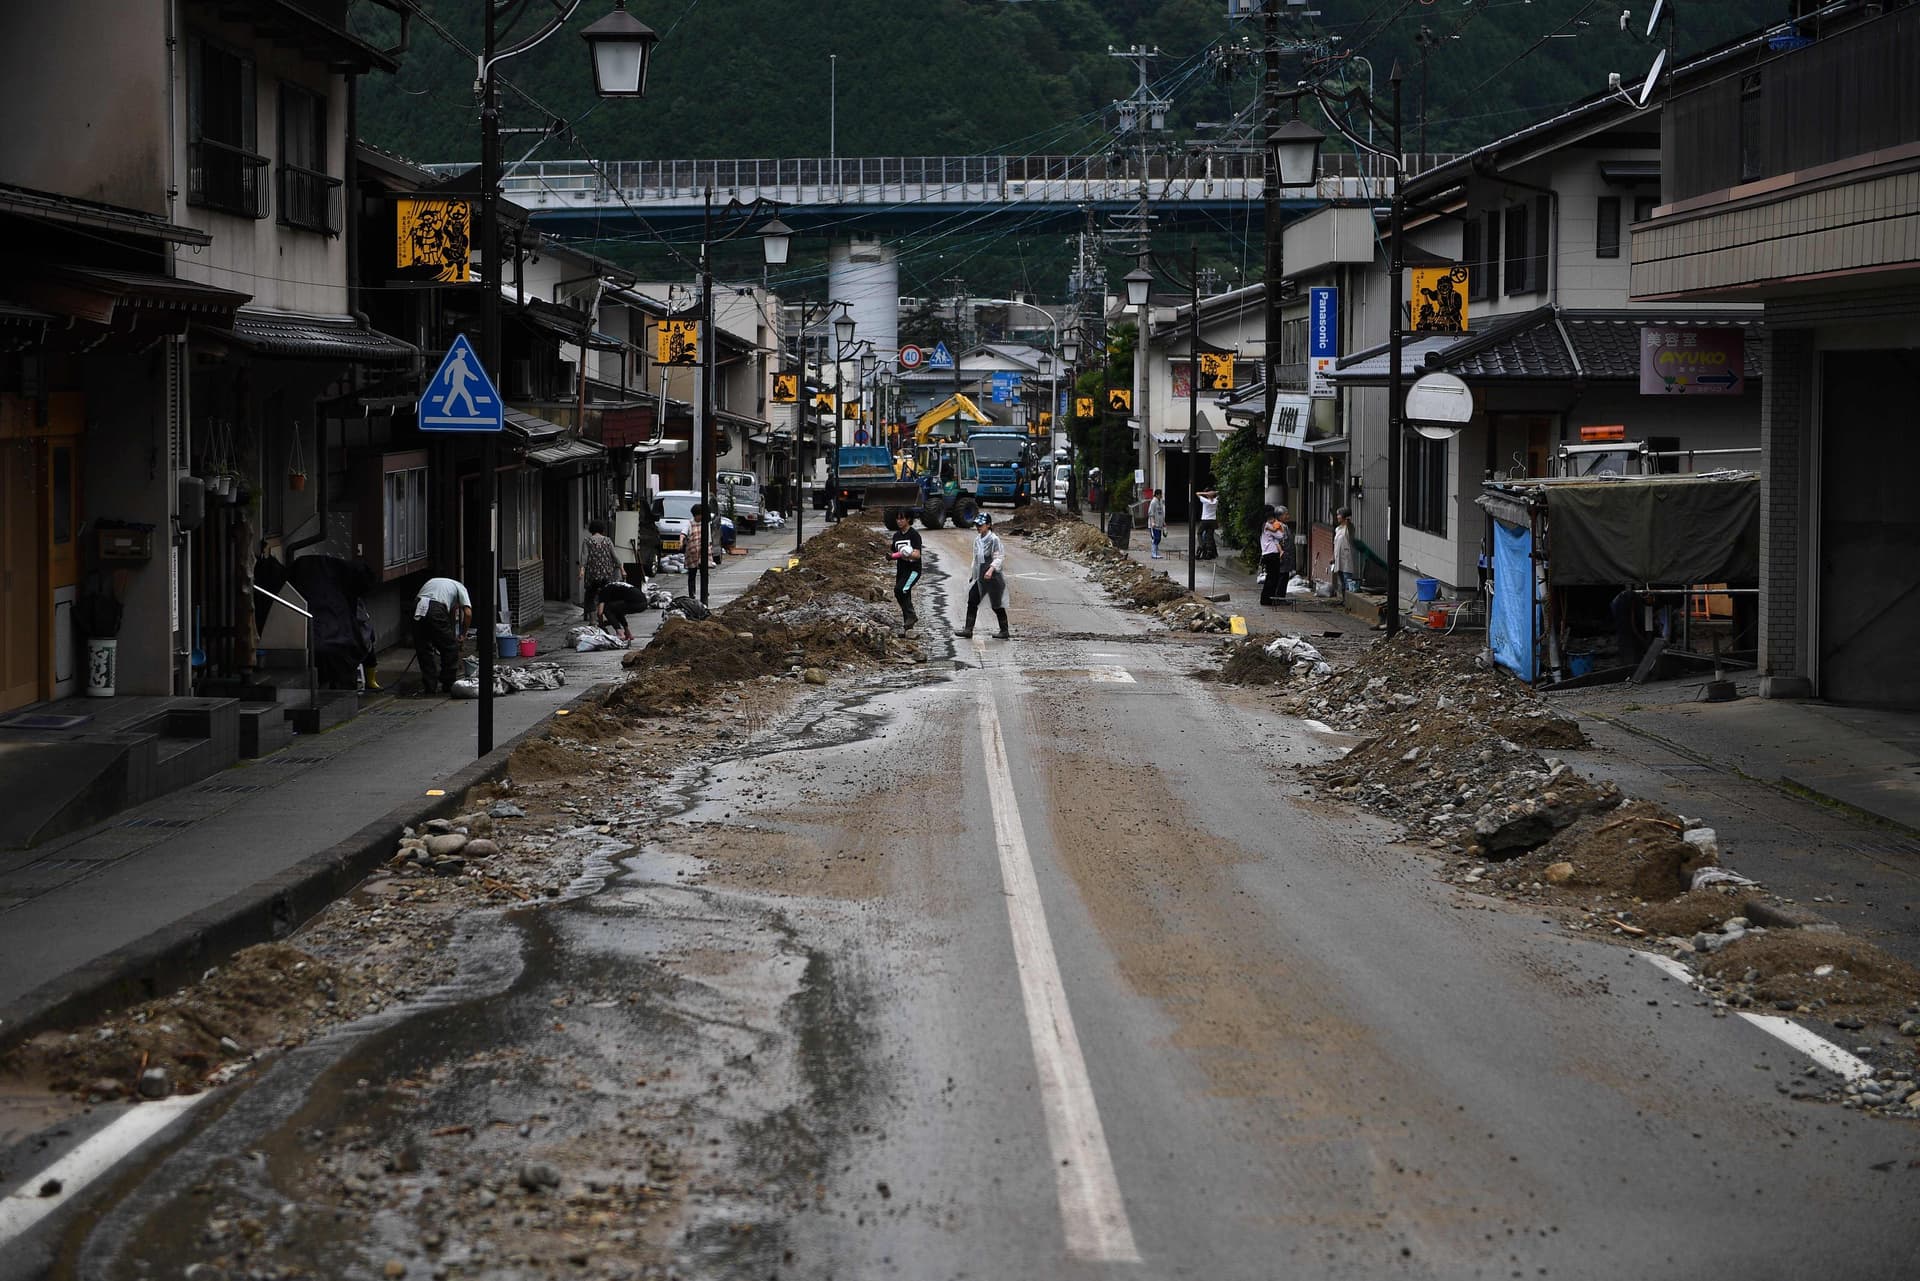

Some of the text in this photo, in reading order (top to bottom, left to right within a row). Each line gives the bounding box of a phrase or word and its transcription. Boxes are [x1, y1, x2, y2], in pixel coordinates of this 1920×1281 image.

[1319, 292, 1328, 349] Panasonic
[1648, 332, 1696, 347] 美容室
[905, 351, 917, 361] 40
[1659, 351, 1727, 365] AYUKO
